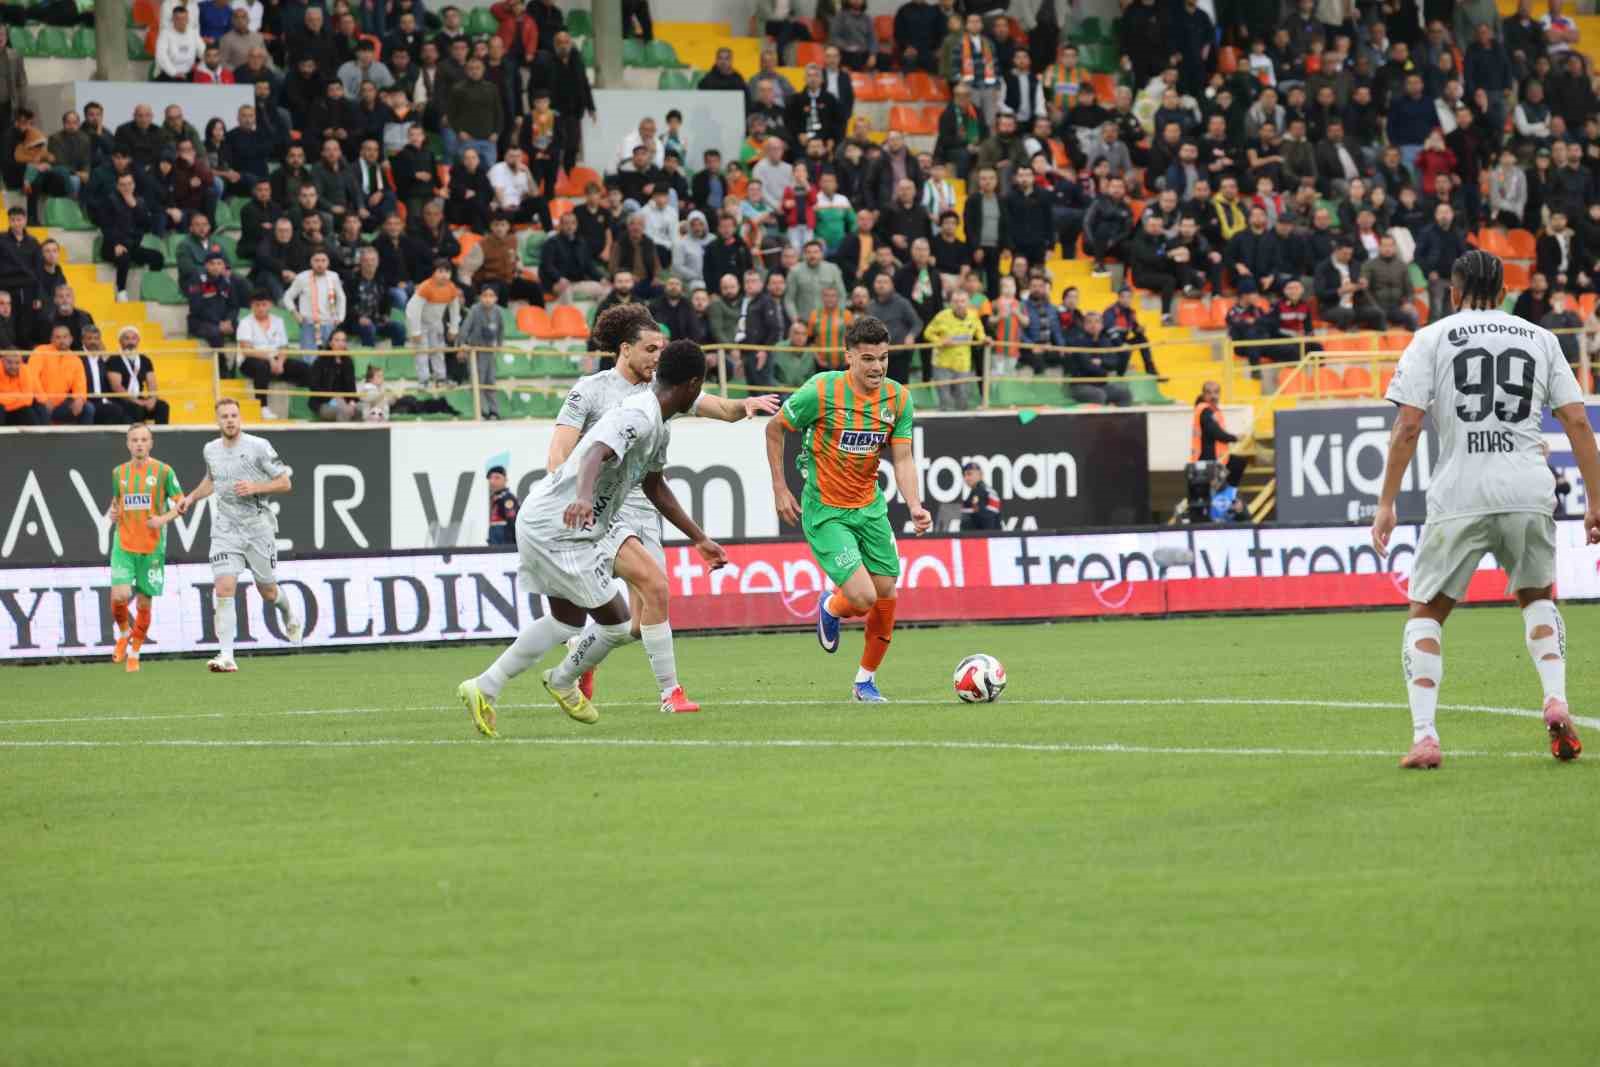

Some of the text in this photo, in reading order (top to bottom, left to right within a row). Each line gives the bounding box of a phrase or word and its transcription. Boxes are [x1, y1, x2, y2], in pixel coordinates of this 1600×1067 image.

[1459, 323, 1535, 340] AUTOPORT
[1453, 347, 1536, 424] 99
[1467, 430, 1514, 453] RIVAS
